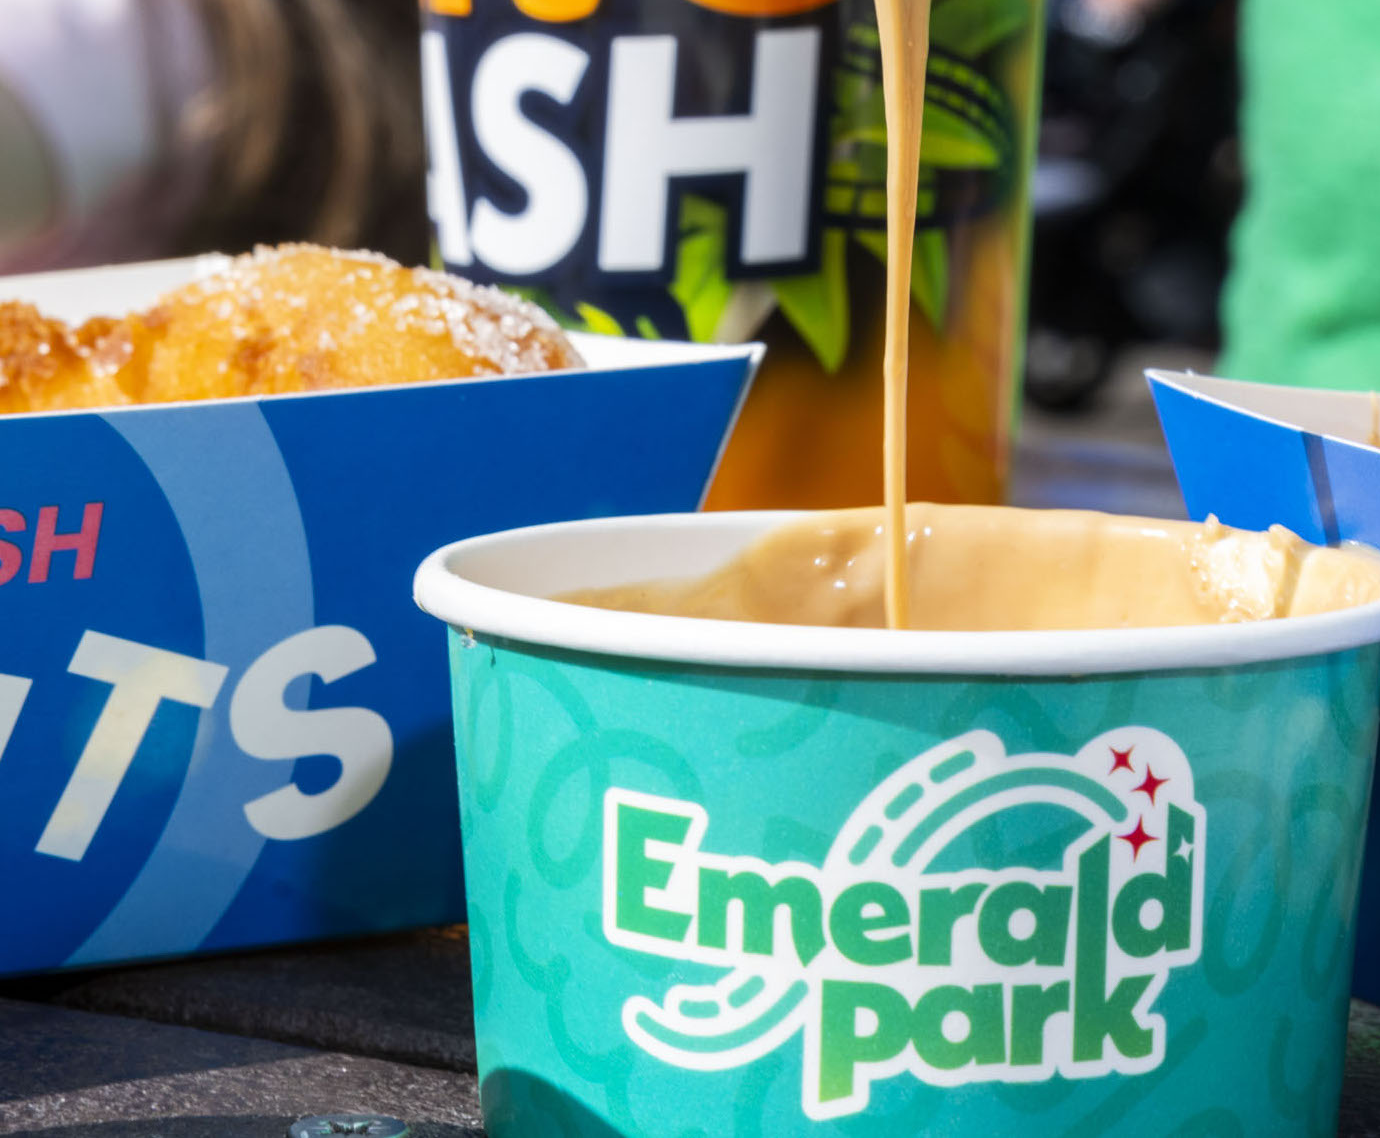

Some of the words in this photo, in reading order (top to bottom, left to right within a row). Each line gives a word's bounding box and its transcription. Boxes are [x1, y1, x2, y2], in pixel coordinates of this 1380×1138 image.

[0, 625, 393, 862] TS
[616, 801, 1196, 968] Emerald
[818, 974, 1158, 1103] park
